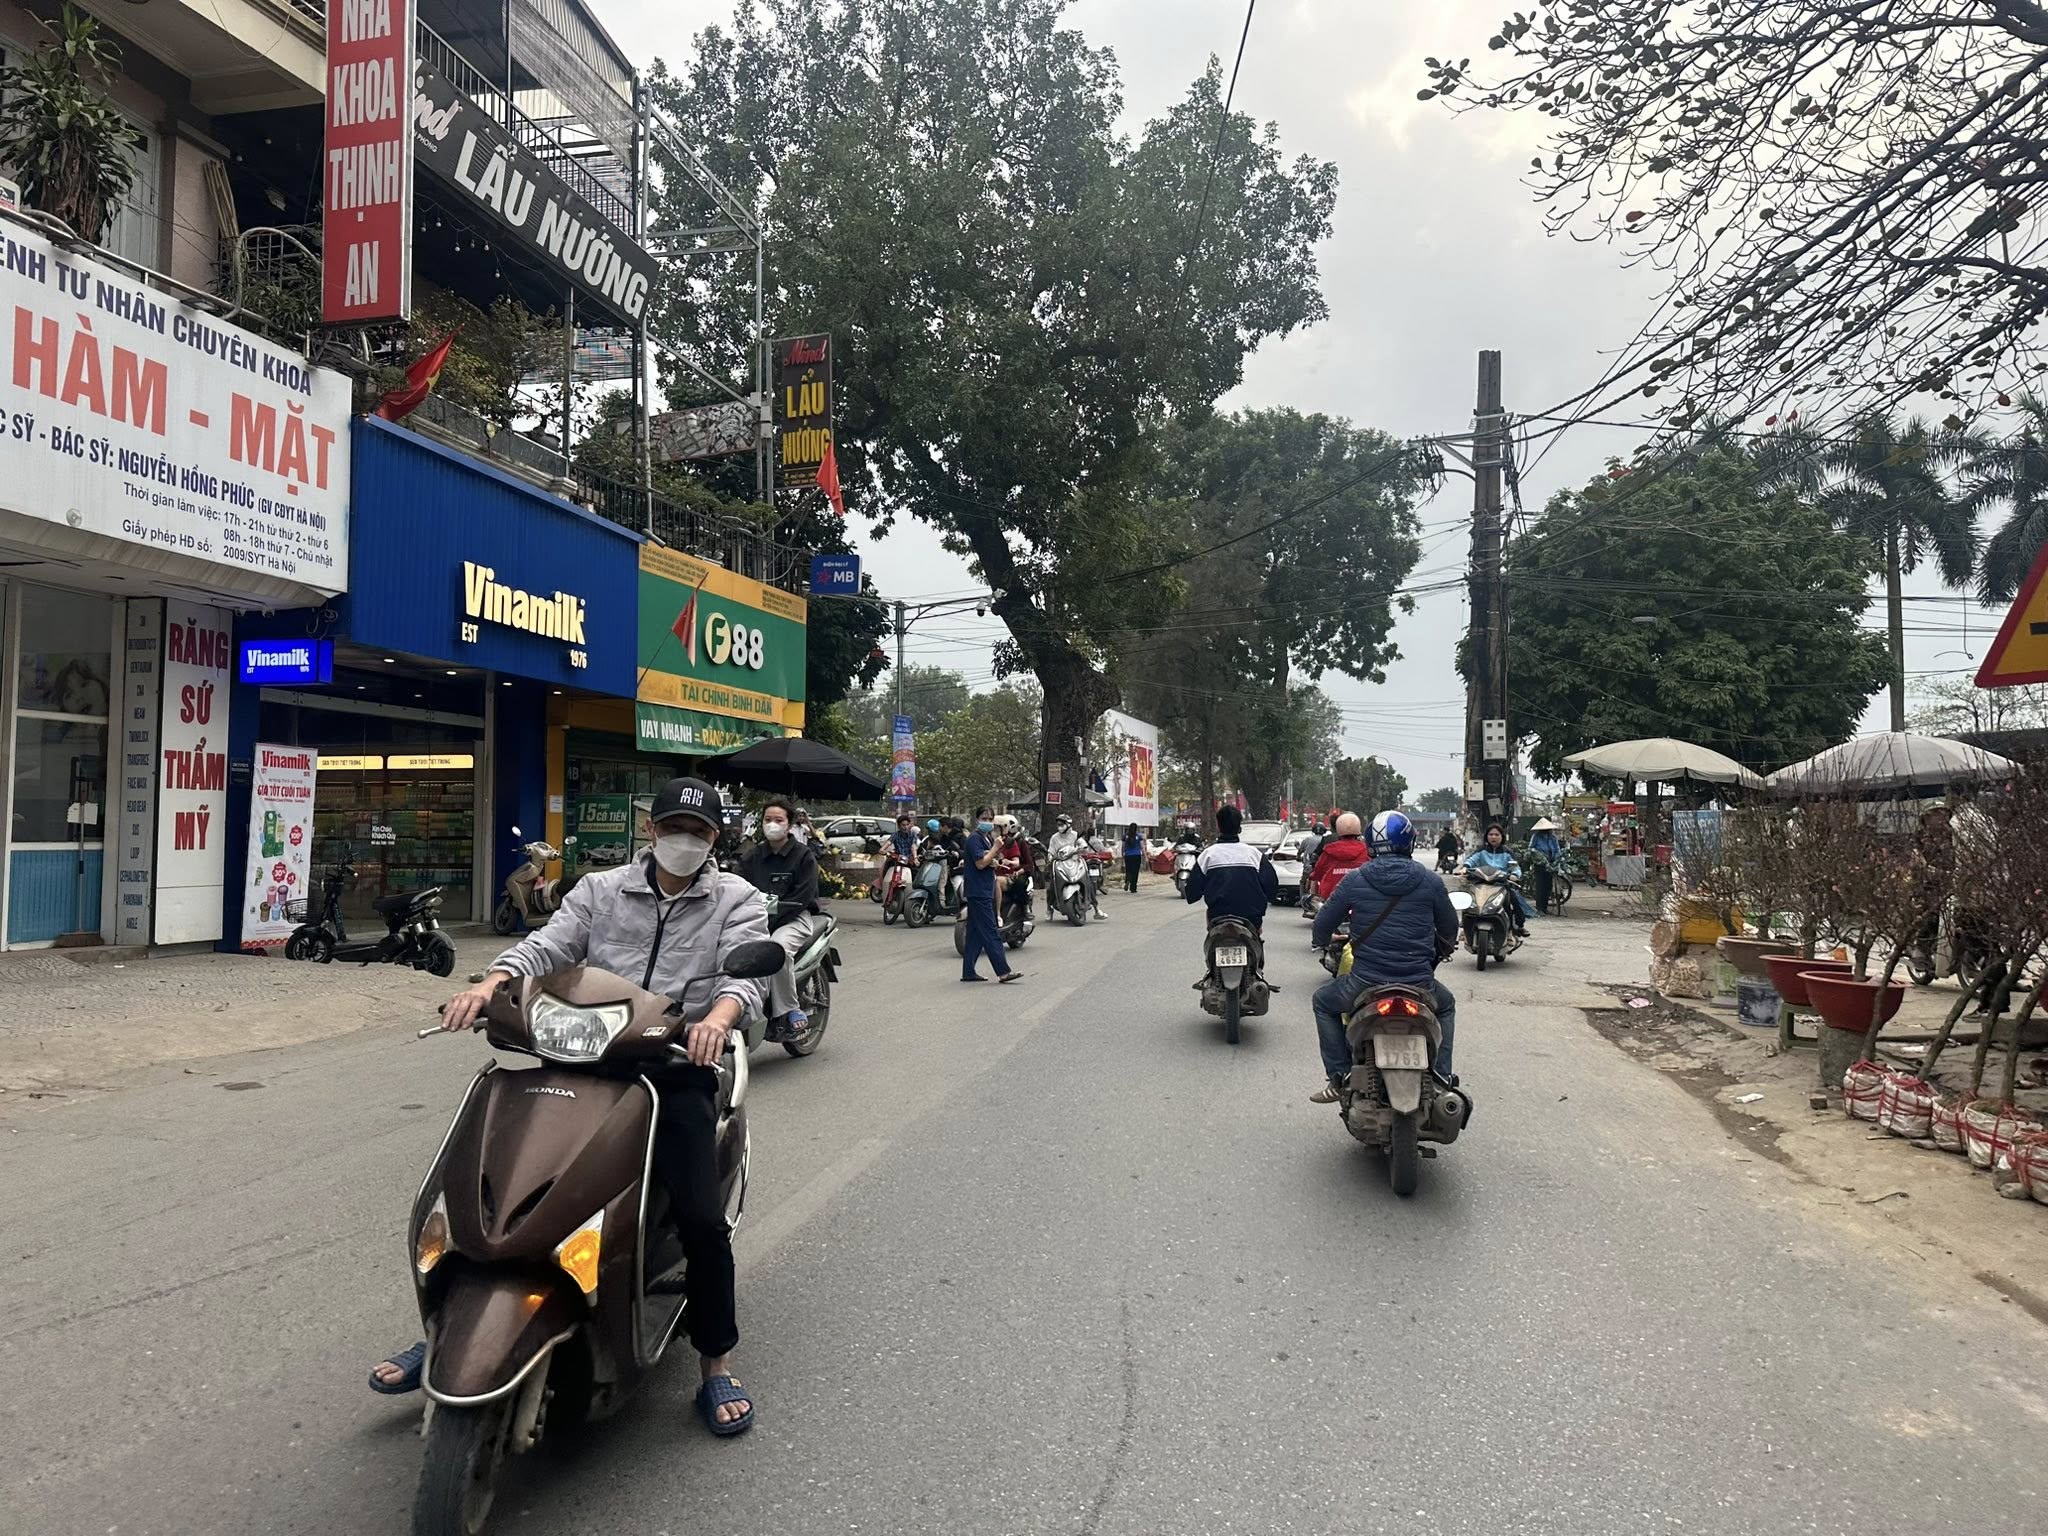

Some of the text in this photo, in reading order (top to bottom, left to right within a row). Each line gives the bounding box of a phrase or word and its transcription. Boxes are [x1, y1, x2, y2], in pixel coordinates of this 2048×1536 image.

[332, 57, 397, 127] KHOA
[329, 140, 399, 222] THỊNH
[454, 129, 648, 319] LẨU NƯỚNG
[344, 240, 379, 307] AN
[55, 261, 90, 300] TƯ
[96, 280, 166, 335] NHÂN
[173, 314, 257, 373] CHUYÊN
[263, 352, 312, 396] KHOA
[13, 304, 168, 437] HÀM
[229, 392, 335, 496] MẶT
[786, 368, 824, 419] LẨU
[783, 419, 830, 465] NƯỚNG
[12, 413, 35, 443] SỸ
[51, 426, 84, 457] BÁC
[89, 438, 114, 468] SỸ:
[118, 447, 177, 486] NGUYỄN
[181, 464, 217, 498] HỒNG
[221, 481, 254, 509] PHÚC
[258, 497, 272, 515] (GV
[297, 508, 307, 525] HÀ
[309, 512, 326, 532] NỘI)
[124, 482, 149, 501] Thời
[152, 493, 174, 508] gian
[178, 497, 195, 513] làm
[199, 505, 221, 521] việc:
[224, 511, 240, 527] 17h
[249, 519, 264, 533] 21h
[267, 523, 277, 536] từ
[279, 526, 295, 540] thứ
[296, 531, 301, 542] 2
[308, 535, 322, 547] thứ
[323, 539, 329, 550] 6
[122, 519, 296, 575] Giấy phép HĐ số: 2009/SYT Hà Nội
[224, 529, 240, 543] 08h
[250, 535, 265, 549] 18h
[267, 540, 283, 554] thứ
[284, 545, 289, 556] 7
[297, 549, 314, 562] Chủ
[315, 555, 333, 567] nhật
[833, 571, 854, 583] MB
[464, 561, 586, 645] Vinamilk
[168, 618, 228, 669] RĂNG
[247, 648, 309, 667] Vinamilk
[462, 622, 587, 669] EST 1976
[180, 680, 214, 724] SỨ
[682, 681, 772, 716] TÀI CHÍNH BÌNH DÂN
[641, 719, 658, 738] VAY
[661, 721, 692, 743] NHANH
[702, 726, 724, 747] ĐĂNG
[164, 737, 225, 791] THẨM
[262, 751, 310, 770] Vinamilk
[175, 804, 210, 850] MỸ
[578, 803, 598, 822] 15
[525, 1087, 577, 1098] HONDA
